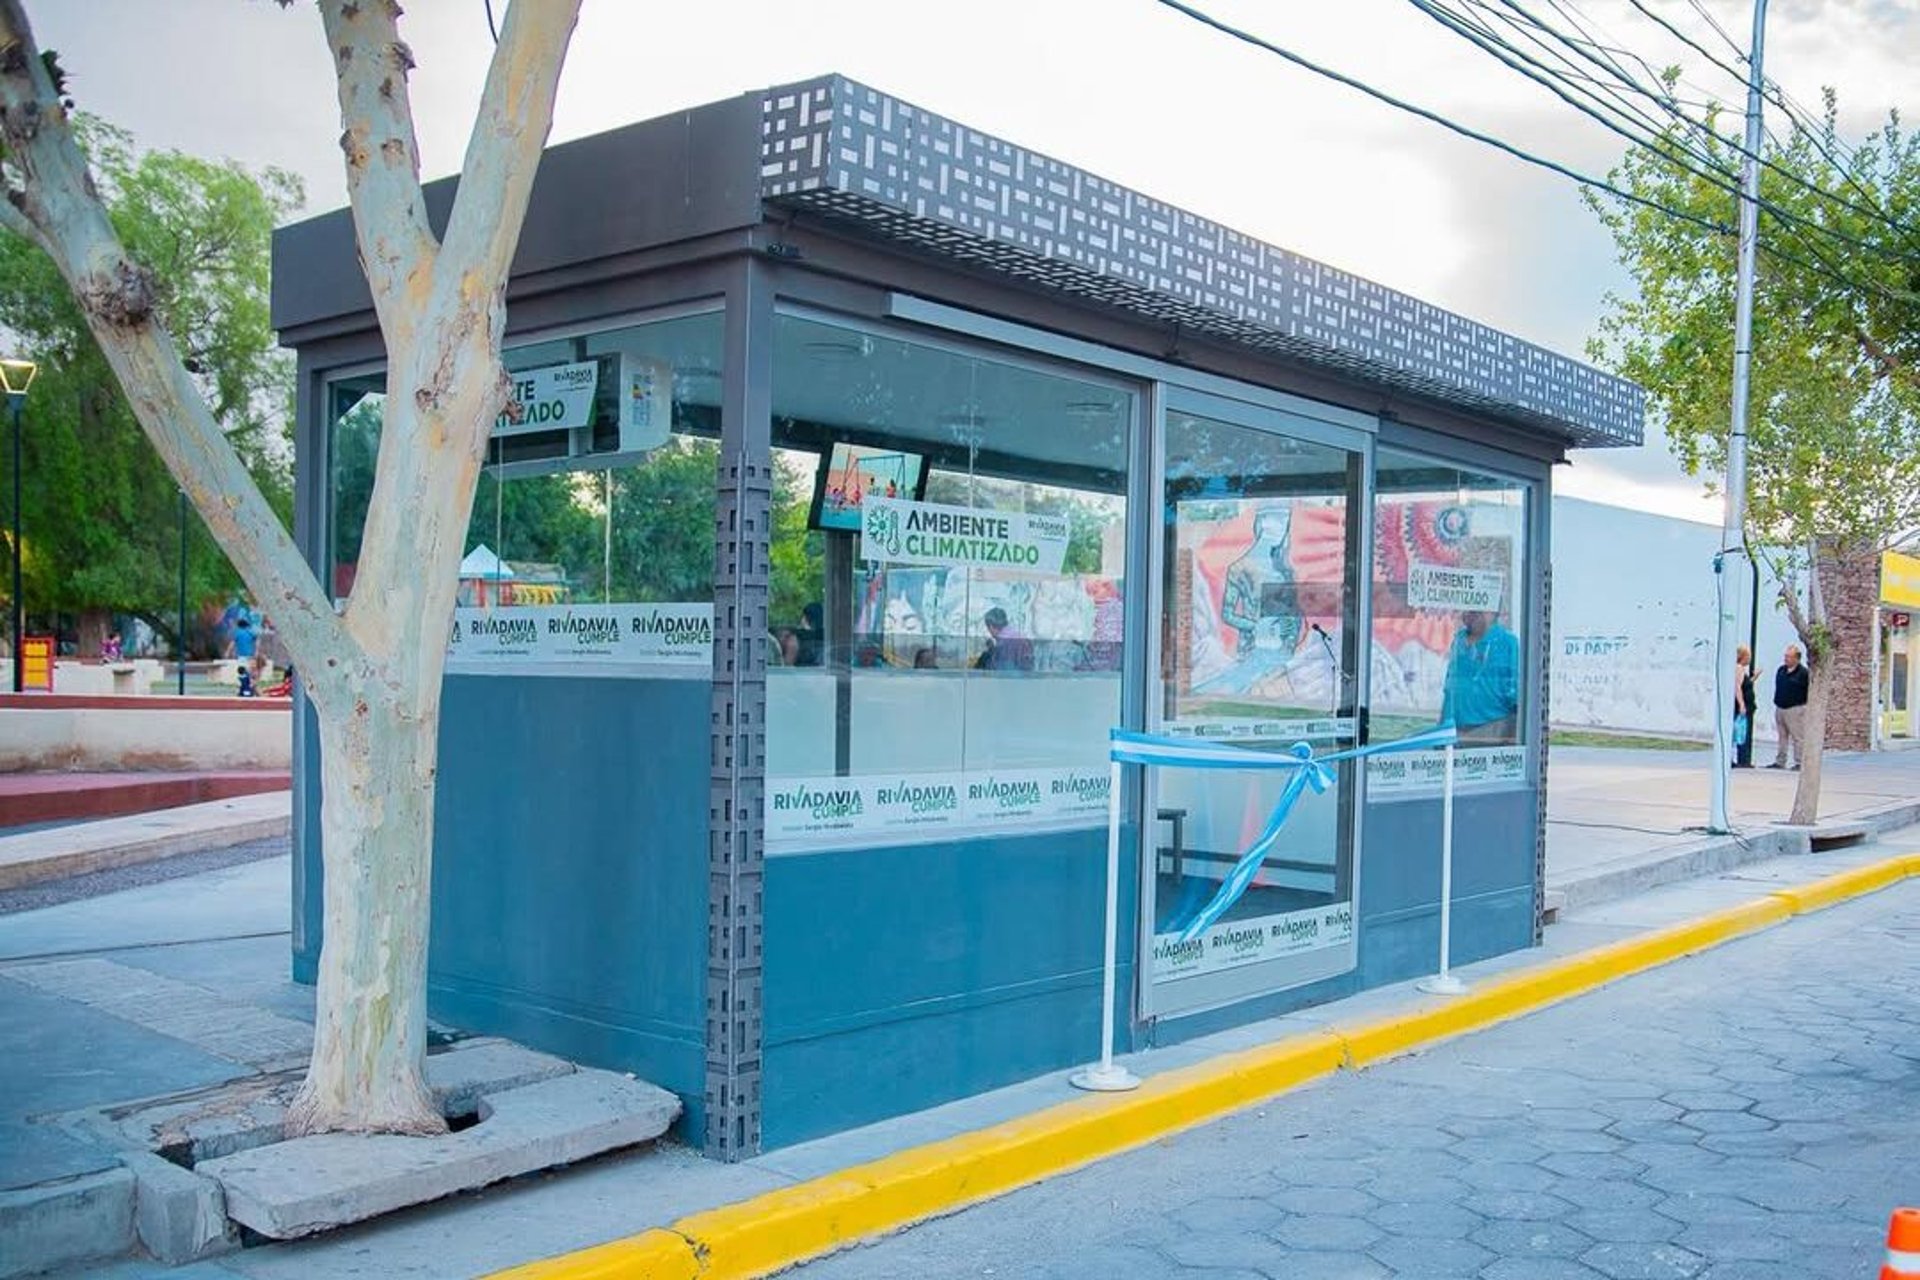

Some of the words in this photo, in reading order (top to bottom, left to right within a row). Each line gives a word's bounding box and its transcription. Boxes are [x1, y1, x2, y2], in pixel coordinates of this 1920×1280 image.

[906, 510, 1009, 539] AMBIENTE
[906, 535, 1039, 565] CLIMATIZADO
[1427, 571, 1475, 589] AMBIENTE
[1427, 588, 1489, 606] CLIMATIZADO
[471, 616, 536, 635] RIVADAVIA
[548, 611, 618, 634] RIVADAVIA
[632, 609, 710, 633] RIVADAVIA
[498, 631, 537, 645] CUMPLE
[577, 631, 620, 644] CUMPLE
[664, 631, 712, 645] CUMPLE
[774, 784, 862, 810] RIVADAVIA
[877, 780, 956, 805] RIVADAVIA
[968, 777, 1040, 799] RIVADAVIA
[1078, 789, 1111, 802] CUMPL
[911, 797, 958, 813] CUMPLE
[1000, 792, 1041, 808] CUMPLE
[812, 804, 863, 820] CUMPLE
[1271, 916, 1317, 937] RIVADAVIA
[1211, 927, 1263, 948] RIVADAVIA
